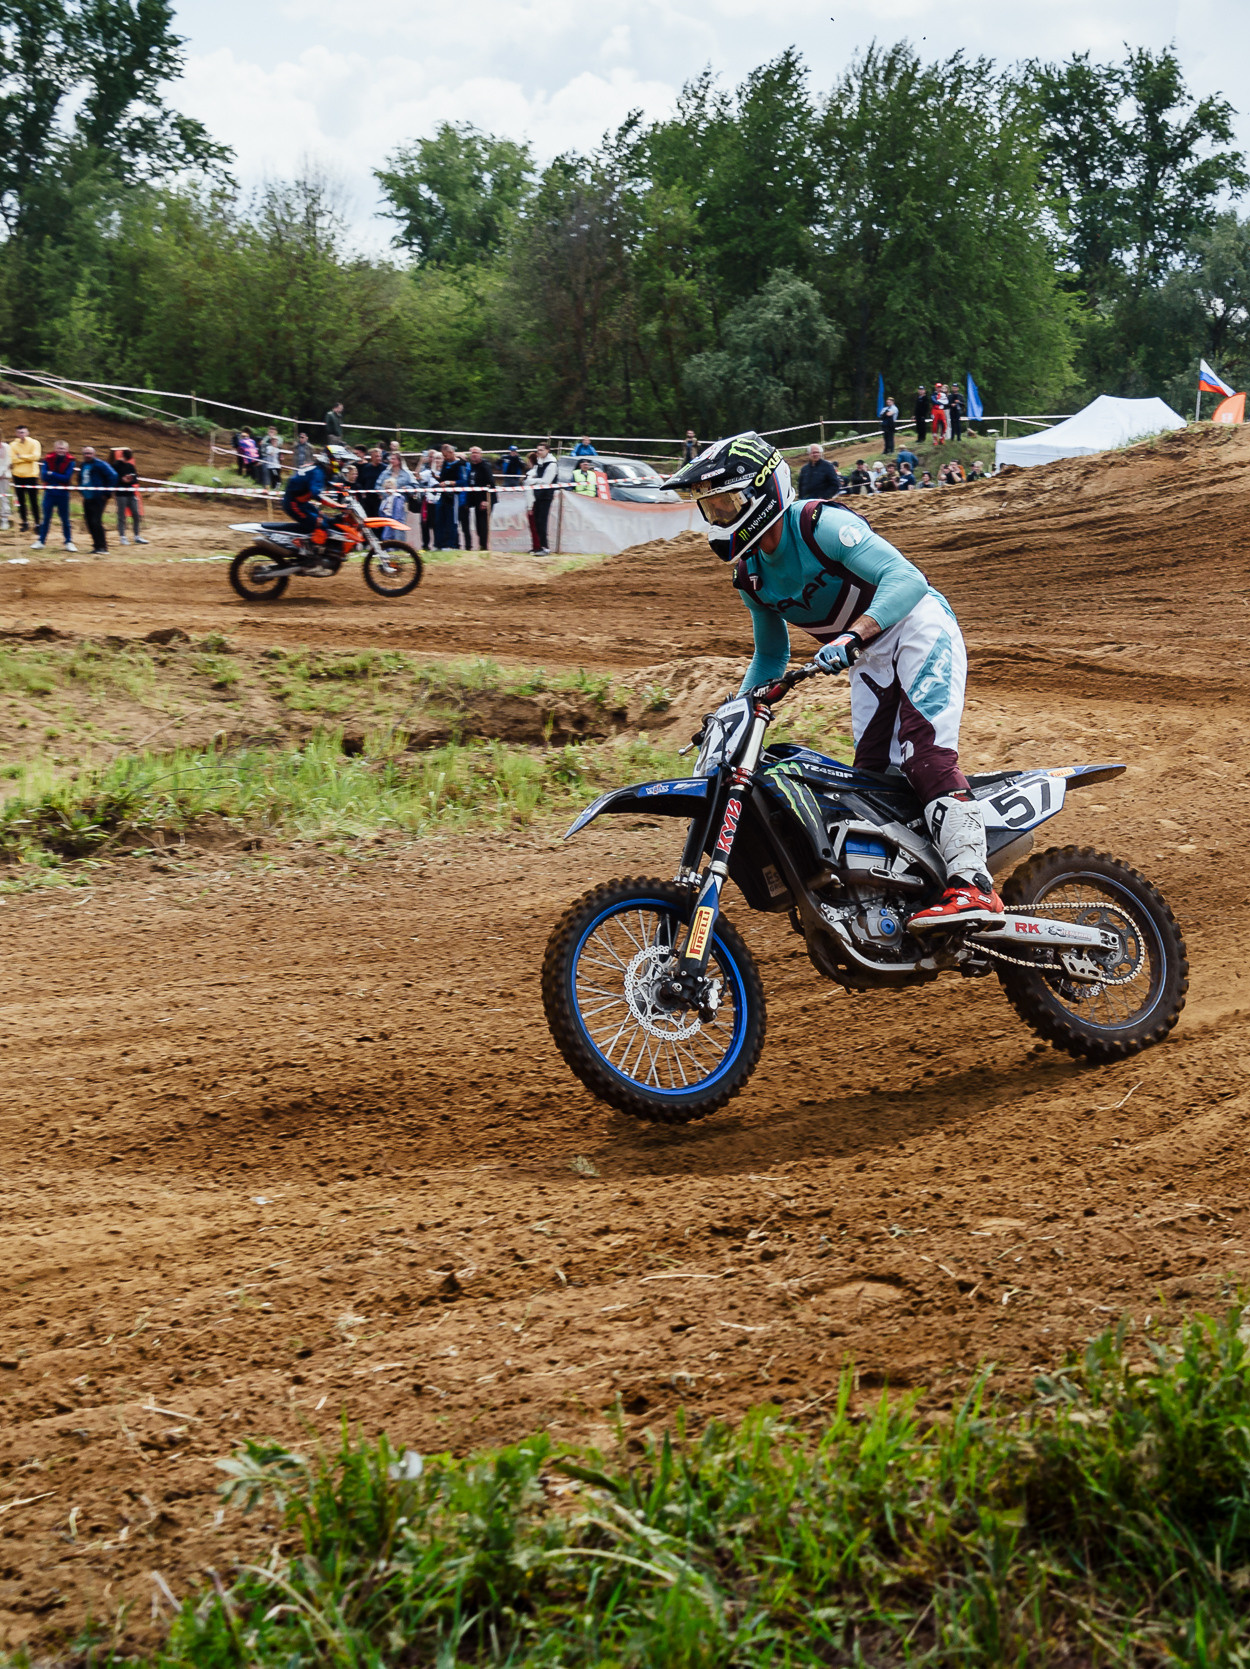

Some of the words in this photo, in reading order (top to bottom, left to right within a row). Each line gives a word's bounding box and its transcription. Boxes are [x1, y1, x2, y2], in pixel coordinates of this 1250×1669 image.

[801, 762, 854, 779] YZ450F
[988, 778, 1051, 828] 57
[716, 798, 742, 855] KYB
[688, 909, 711, 955] PIRELLI
[1014, 922, 1041, 934] RK
